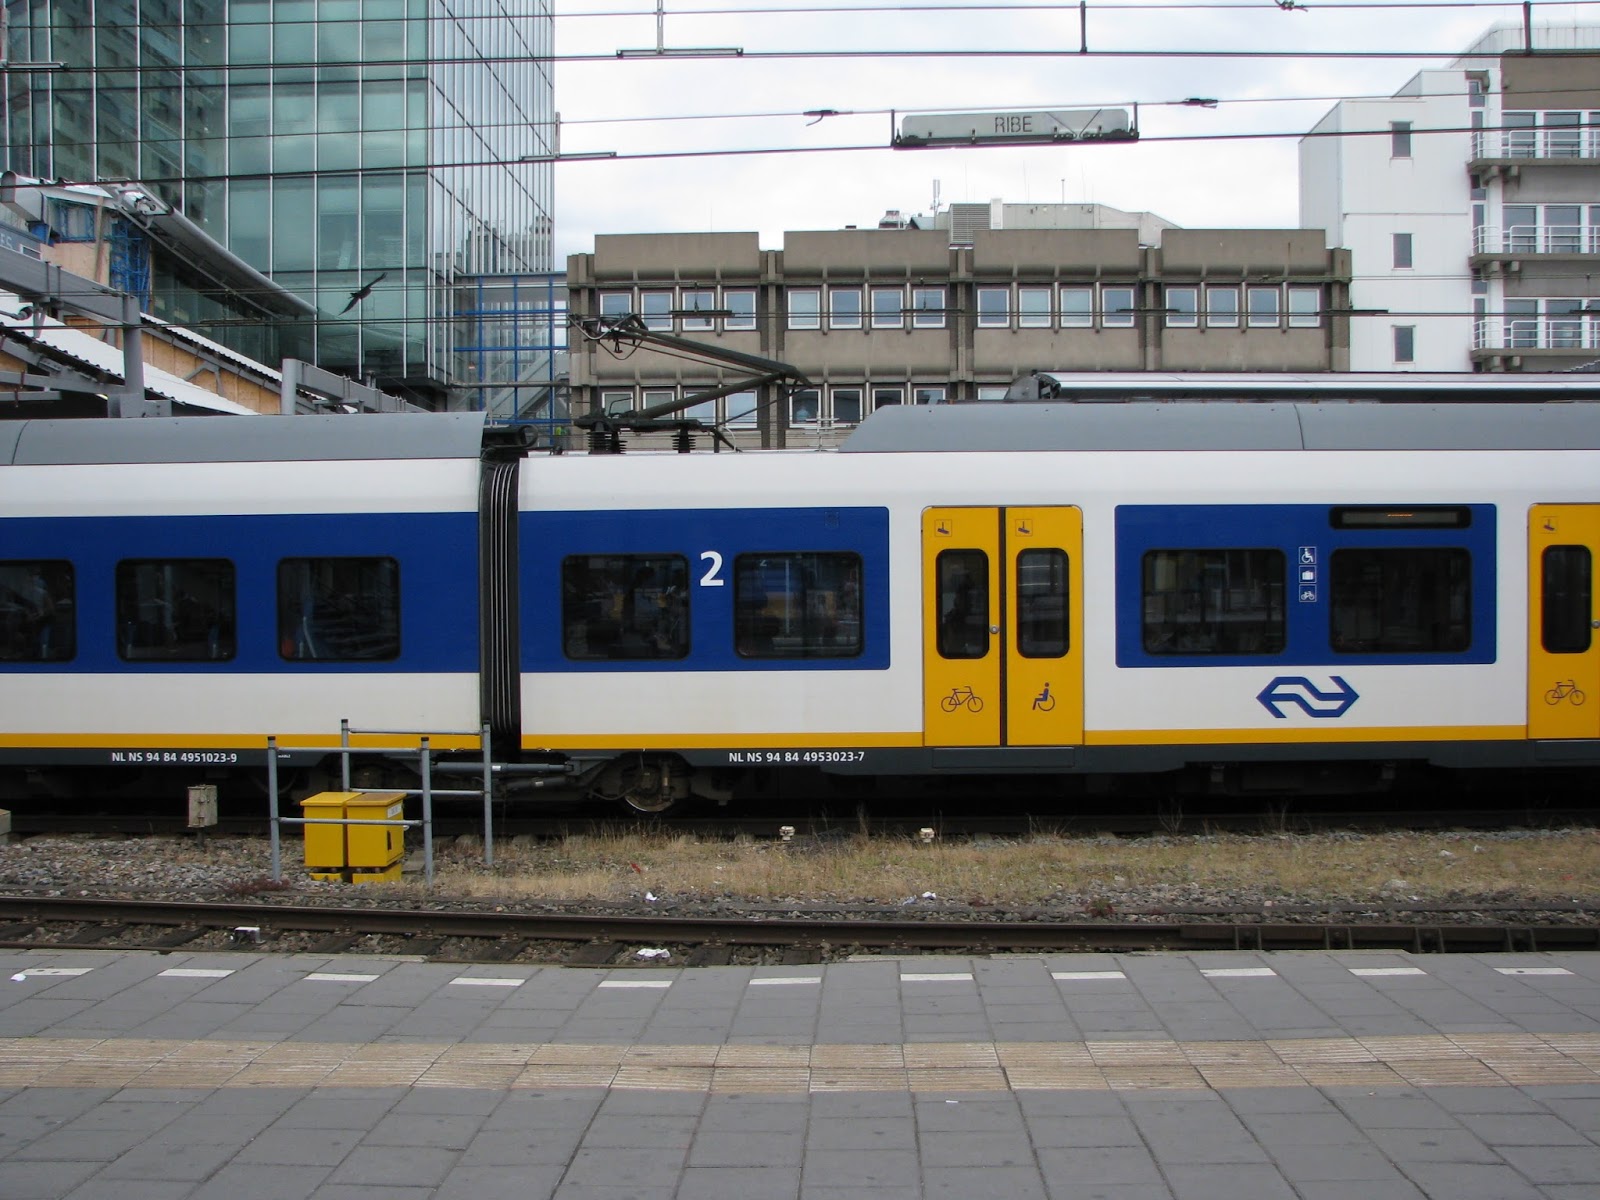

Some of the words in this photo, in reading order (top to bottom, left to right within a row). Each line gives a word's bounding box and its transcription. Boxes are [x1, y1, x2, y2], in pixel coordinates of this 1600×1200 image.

[994, 116, 1033, 133] RIBE
[700, 550, 725, 587] 2
[111, 752, 126, 762] NL
[128, 752, 143, 762] NS
[146, 752, 160, 762] 94
[163, 752, 177, 762] 84
[180, 752, 238, 763] 4951023-9
[728, 752, 744, 762] NL
[746, 752, 762, 762] NS
[766, 752, 781, 762] 94
[784, 752, 799, 762] 84
[803, 751, 865, 762] 4953023-7
